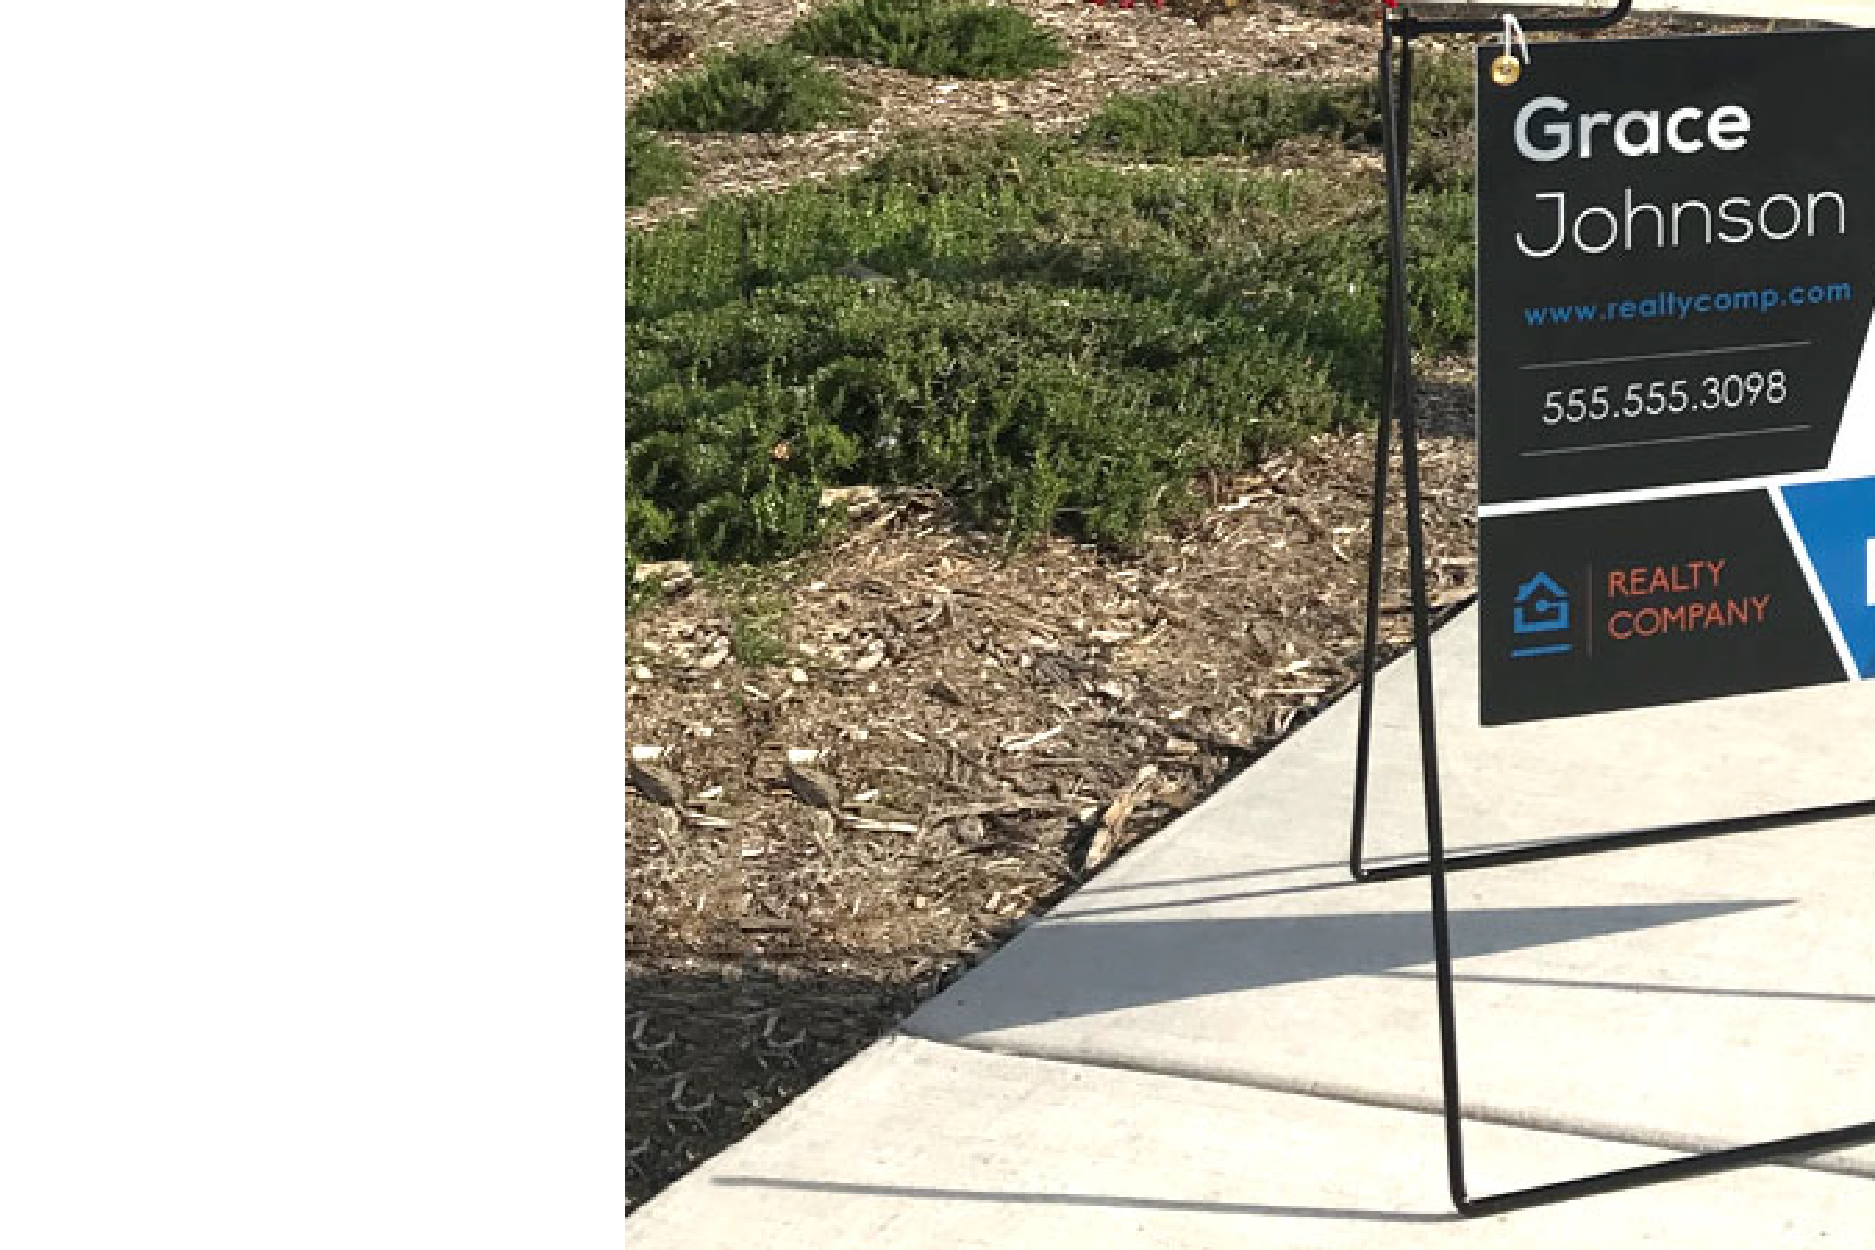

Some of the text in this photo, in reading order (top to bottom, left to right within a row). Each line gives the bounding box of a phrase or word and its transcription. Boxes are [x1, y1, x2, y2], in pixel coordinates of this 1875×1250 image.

[1513, 96, 1751, 162] Grace
[1515, 186, 1846, 258] Johnson
[1523, 281, 1853, 327] www.realtycomp.com
[1542, 368, 1788, 425] 555.555.3098
[1607, 560, 1726, 597] REALTY
[1607, 594, 1772, 640] COMPANY
